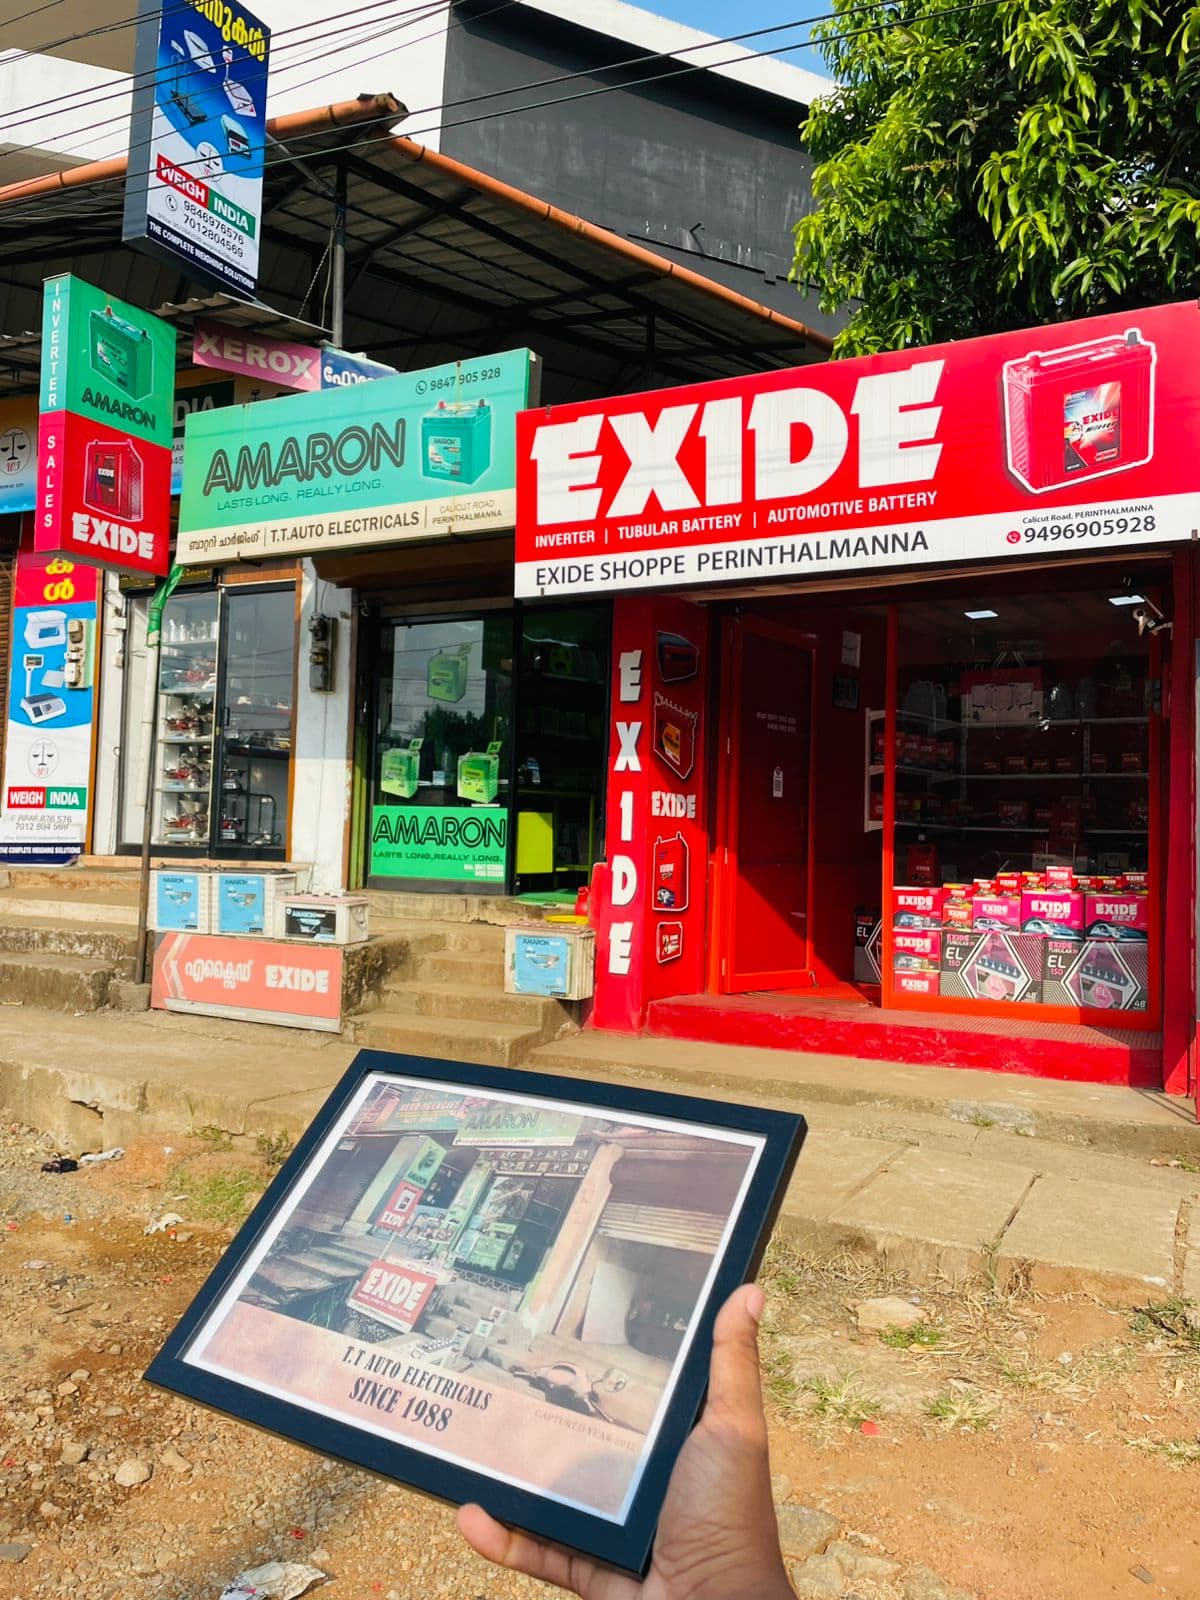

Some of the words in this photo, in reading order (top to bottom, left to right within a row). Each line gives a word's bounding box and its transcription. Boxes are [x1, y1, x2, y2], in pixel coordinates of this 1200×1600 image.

[160, 162, 206, 203] WEIGH
[213, 197, 249, 231] INDIA
[149, 221, 162, 236] THE
[162, 228, 195, 254] COMPLETE
[184, 200, 244, 245] 9846976576
[184, 214, 244, 258] 7012804569
[48, 283, 61, 407] INVERTER
[197, 332, 315, 380] XEROX
[430, 376, 456, 391] 9847
[459, 372, 478, 385] 905
[481, 368, 501, 381] 928
[82, 387, 156, 431] AMARON
[203, 418, 406, 497] AMARON
[530, 359, 946, 526] EXIDE
[43, 435, 56, 527] SALES
[217, 497, 253, 511] LASTS
[296, 481, 343, 499] REALLY
[432, 510, 502, 525] PERINTHALMANNA
[440, 502, 471, 513] CALICUT
[472, 499, 495, 508] ROAD
[535, 529, 595, 548] INVERTER
[617, 520, 678, 540] TUBULAR
[682, 513, 742, 534] BATTERY
[768, 500, 863, 525] AUTOMOTIVE
[868, 490, 938, 513] BATTERY
[1022, 514, 1049, 524] Calicut
[1075, 504, 1154, 519] PERINTHALMANNA
[72, 512, 154, 560] EXIDE
[271, 523, 324, 543] T.T.AUTO
[328, 511, 419, 536] ELECTRICALS
[1024, 515, 1156, 543] 9496905928
[536, 564, 594, 586] EXIDE
[600, 554, 685, 580] SHOPPE
[697, 530, 929, 572] PERINTHALMANNA
[10, 791, 44, 805] WEIGH
[50, 791, 80, 806] INDIA
[608, 649, 642, 975] EXIDE
[651, 790, 696, 819] EXIDE
[373, 815, 506, 848] AMARON
[898, 895, 933, 906] EXIDE
[982, 903, 1008, 913] EXIDE
[1030, 900, 1071, 913] EXIDE
[1095, 903, 1138, 915] EXIDE
[856, 926, 869, 937] EL
[895, 937, 932, 947] EXIDE
[945, 947, 963, 960] EL
[1047, 955, 1066, 968] EL
[265, 964, 329, 993] EXIDE
[361, 1267, 427, 1311] EXIDE
[342, 1345, 366, 1367] T.T
[364, 1353, 402, 1379] AUTO
[402, 1365, 493, 1411] ELECTRICALS
[349, 1376, 402, 1414] SINCE
[401, 1396, 453, 1432] 1988
